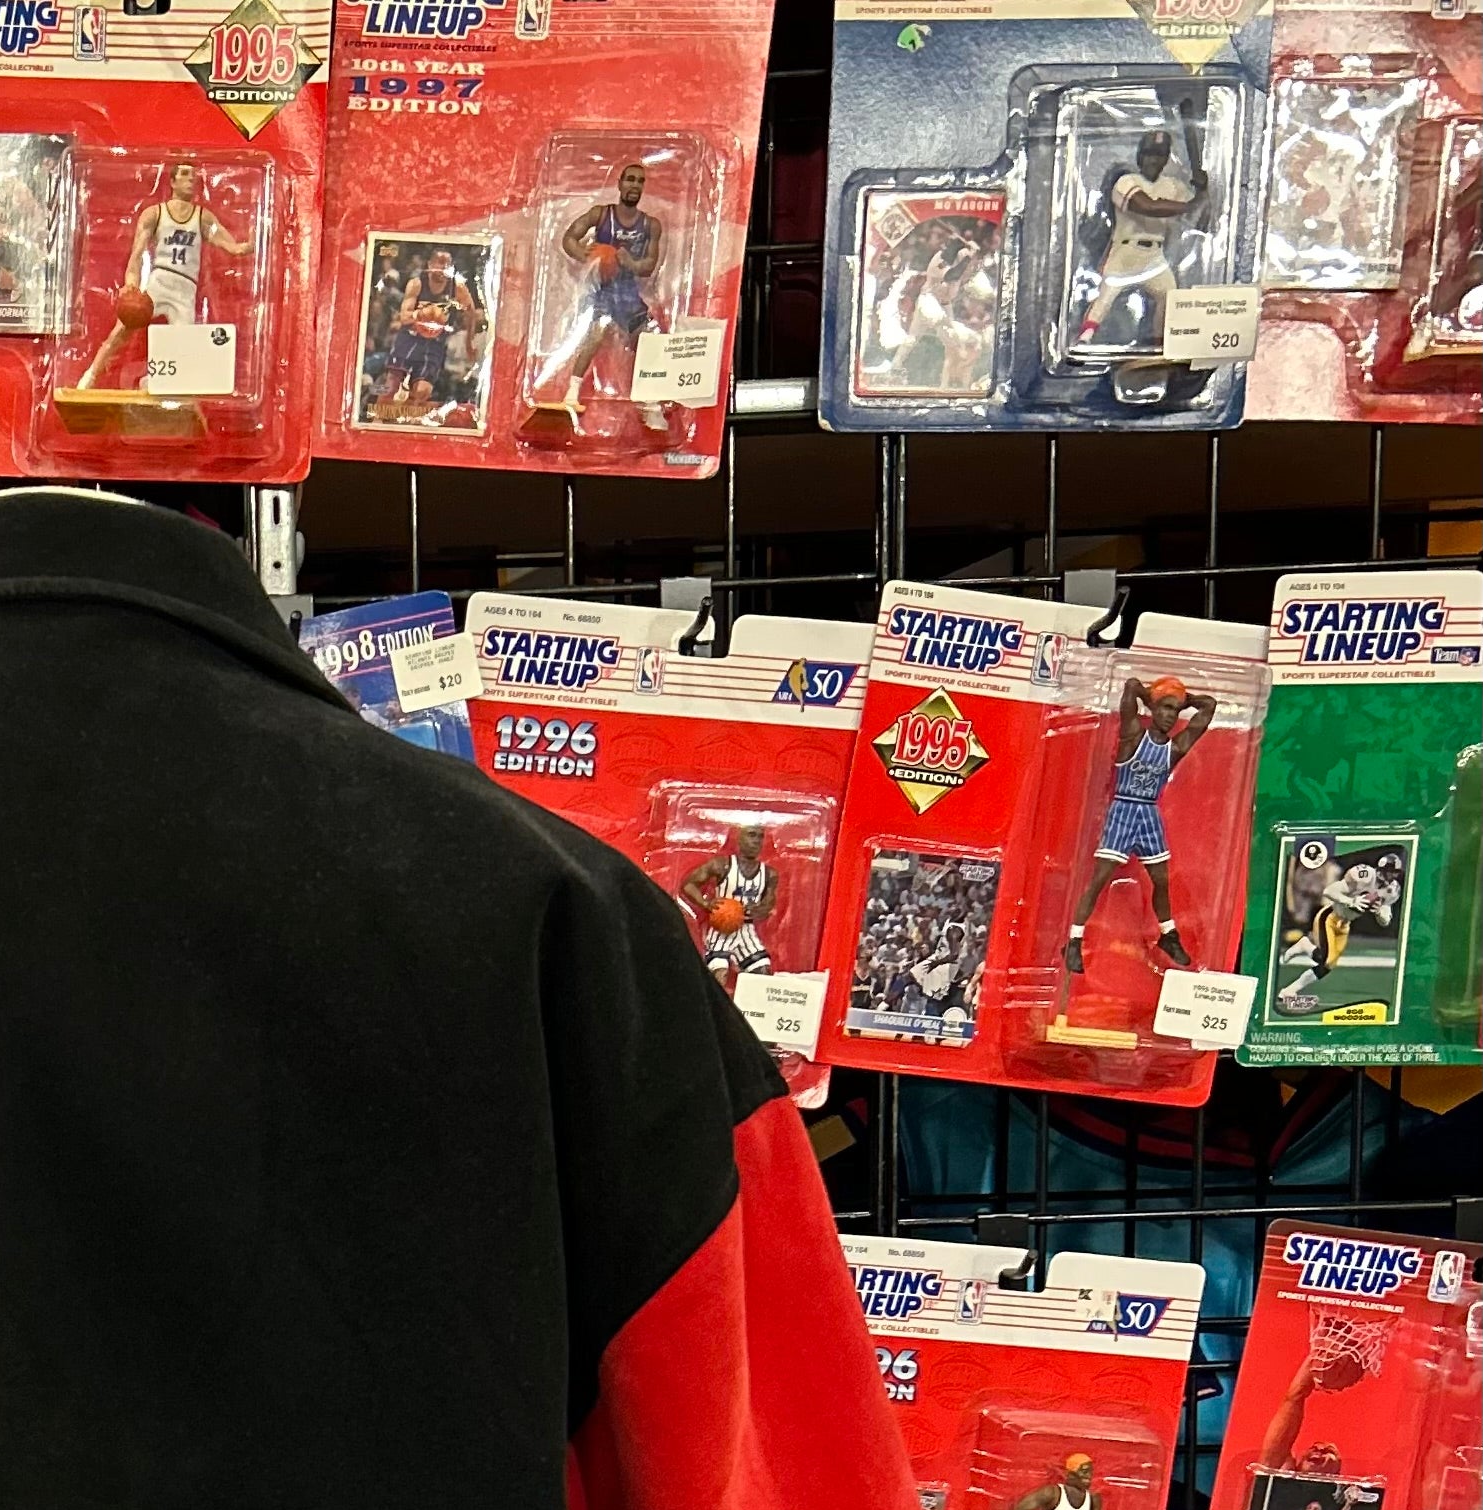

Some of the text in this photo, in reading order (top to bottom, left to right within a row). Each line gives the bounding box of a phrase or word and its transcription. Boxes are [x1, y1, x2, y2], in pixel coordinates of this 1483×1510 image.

[366, 7, 484, 37] LINEUP
[1156, 24, 1235, 38] EDITION
[208, 24, 298, 85] 1995
[351, 58, 486, 76] 10th YEAR
[215, 90, 290, 101] EDITION
[348, 76, 484, 99] 1997
[347, 96, 482, 116] EDITION
[934, 199, 1000, 212] MO VAUGHN
[171, 248, 187, 265] 14
[1211, 332, 1240, 348] $20
[147, 360, 177, 376] $25
[678, 372, 702, 387] $20
[889, 606, 1024, 650] STARTING
[1282, 601, 1446, 635] STARTING
[316, 632, 375, 675] 1998
[376, 624, 436, 657] EDITION
[484, 629, 619, 665] STARTING
[903, 637, 1003, 672] LINEUP
[1304, 633, 1422, 662] LINEUP
[1433, 648, 1459, 662] Team
[439, 672, 463, 690] $20
[501, 658, 599, 688] LINEUP
[884, 669, 1011, 693] SPORTS SUPERSTAR COLLECTIBLES
[1371, 670, 1436, 679] COLLECTIBLES
[811, 669, 841, 699] 50
[494, 715, 597, 756] 1996
[894, 712, 973, 770] 1995
[493, 753, 595, 778] EDITION
[894, 767, 959, 786] EDITION
[776, 1018, 801, 1032] $25
[873, 1014, 912, 1029] SHAQUILLE
[1201, 1015, 1228, 1031] $25
[1249, 1053, 1283, 1062] HAZARD
[1338, 1053, 1367, 1062] UNDER
[1368, 1053, 1384, 1062] THE
[1385, 1053, 1401, 1062] AGE
[1402, 1053, 1413, 1062] OF
[1286, 1236, 1420, 1274] STARTING
[1302, 1263, 1398, 1295] LINEUP
[1120, 1301, 1156, 1330] 50
[881, 1324, 940, 1335] COLLECTIBLES
